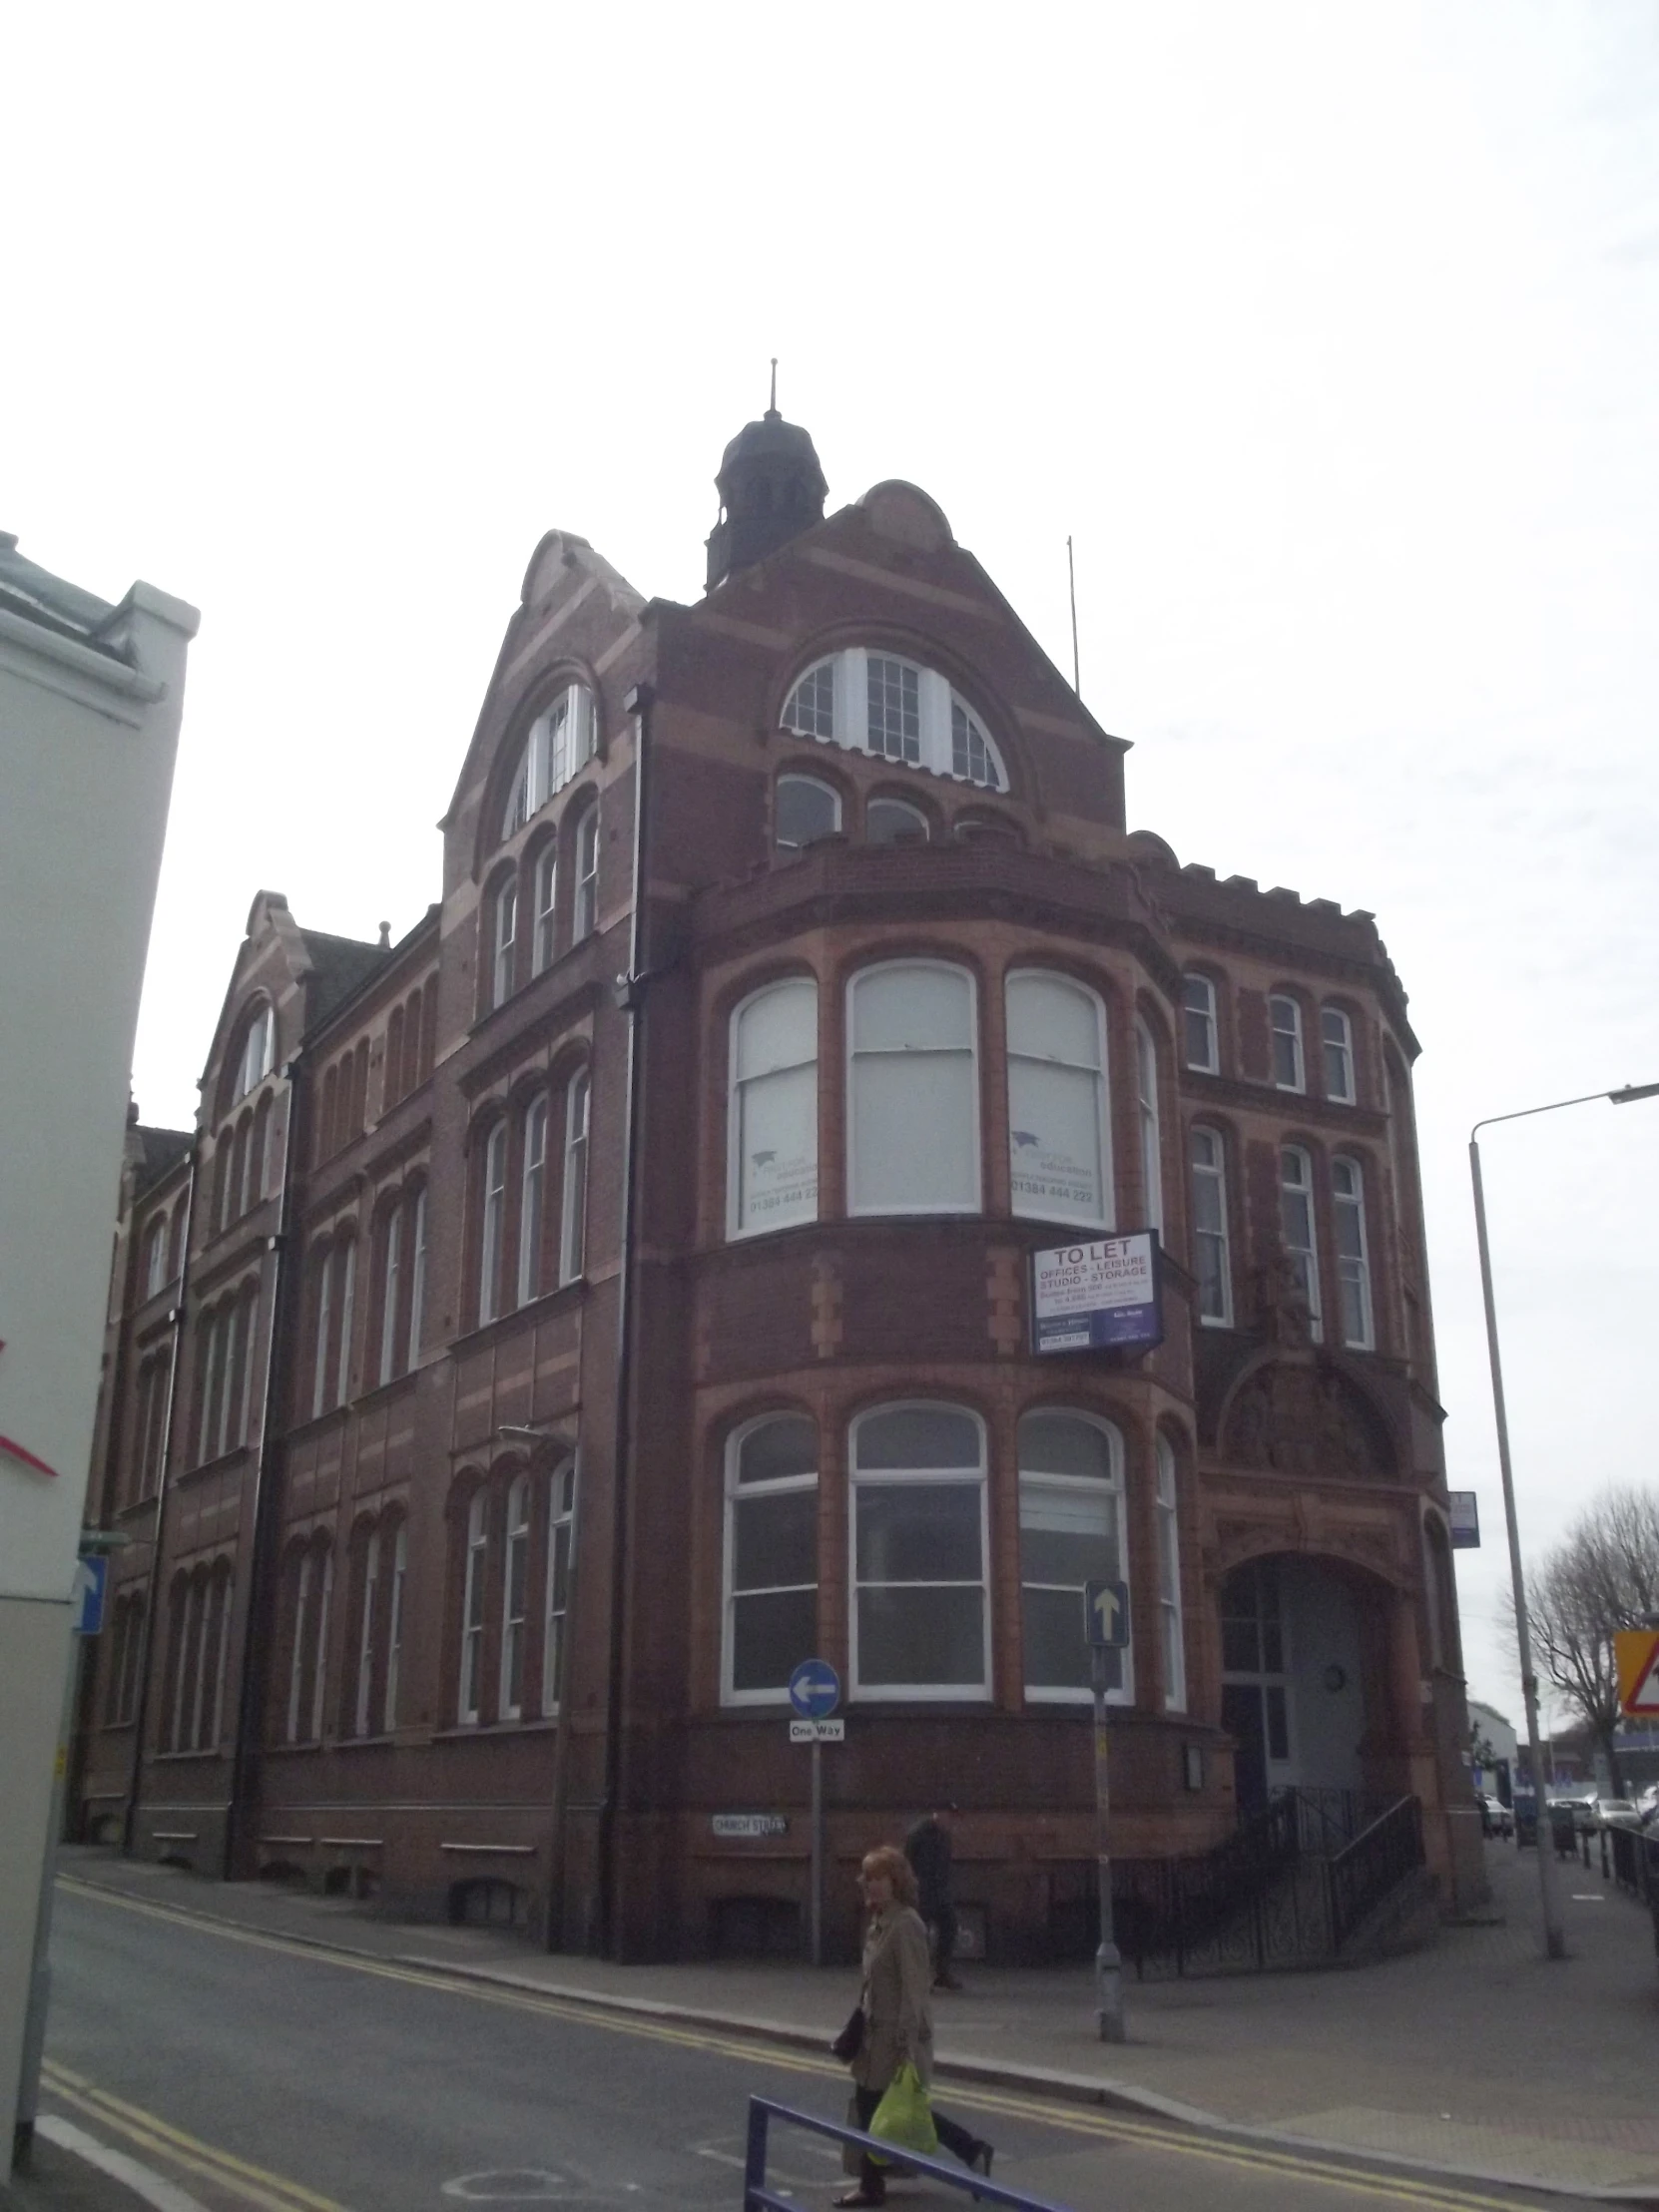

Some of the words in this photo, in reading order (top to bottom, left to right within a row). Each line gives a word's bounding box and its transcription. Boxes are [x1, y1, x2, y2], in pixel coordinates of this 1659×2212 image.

[1011, 1181, 1045, 1195] 01384
[1049, 1186, 1070, 1198] 444
[1073, 1189, 1093, 1203] 222
[1054, 1248, 1084, 1266] TO
[1090, 1240, 1131, 1261] LET
[1040, 1264, 1088, 1280] OFFICES
[1097, 1256, 1146, 1271] LEISURE
[1040, 1276, 1082, 1291] STUDIO
[1091, 1266, 1147, 1282] STORAGE
[792, 1726, 813, 1736] One
[817, 1725, 840, 1736] Way
